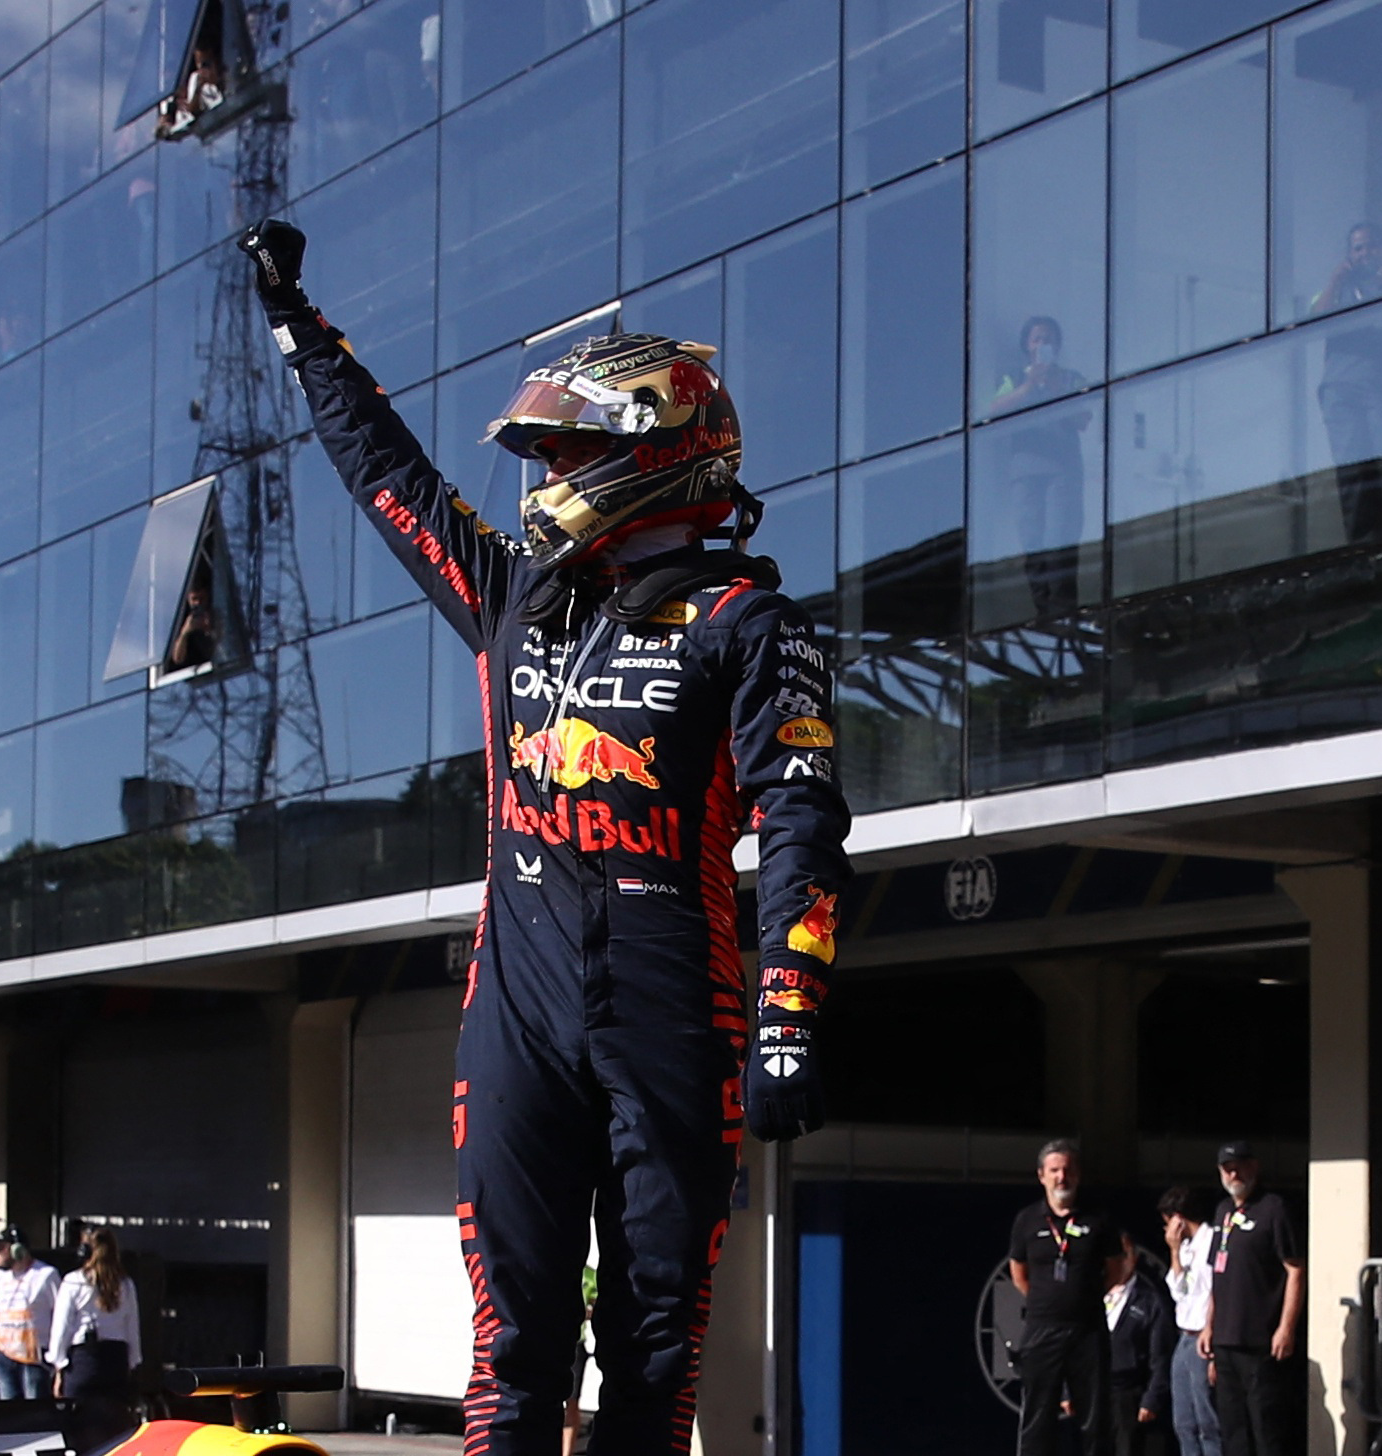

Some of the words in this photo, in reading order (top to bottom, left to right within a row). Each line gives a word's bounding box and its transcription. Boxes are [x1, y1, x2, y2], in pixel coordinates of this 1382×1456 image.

[634, 432, 692, 474] Red
[374, 488, 418, 534] GIVES
[412, 527, 445, 564] YOU
[618, 632, 684, 652] BYBIT
[610, 657, 683, 671] HONDA
[511, 664, 682, 713] ORACLE
[502, 779, 571, 845] Red
[576, 800, 682, 861] Bull
[644, 882, 680, 895] MAX
[949, 867, 991, 907] FIA
[762, 967, 799, 988] Bull
[760, 1025, 812, 1042] Mobil
